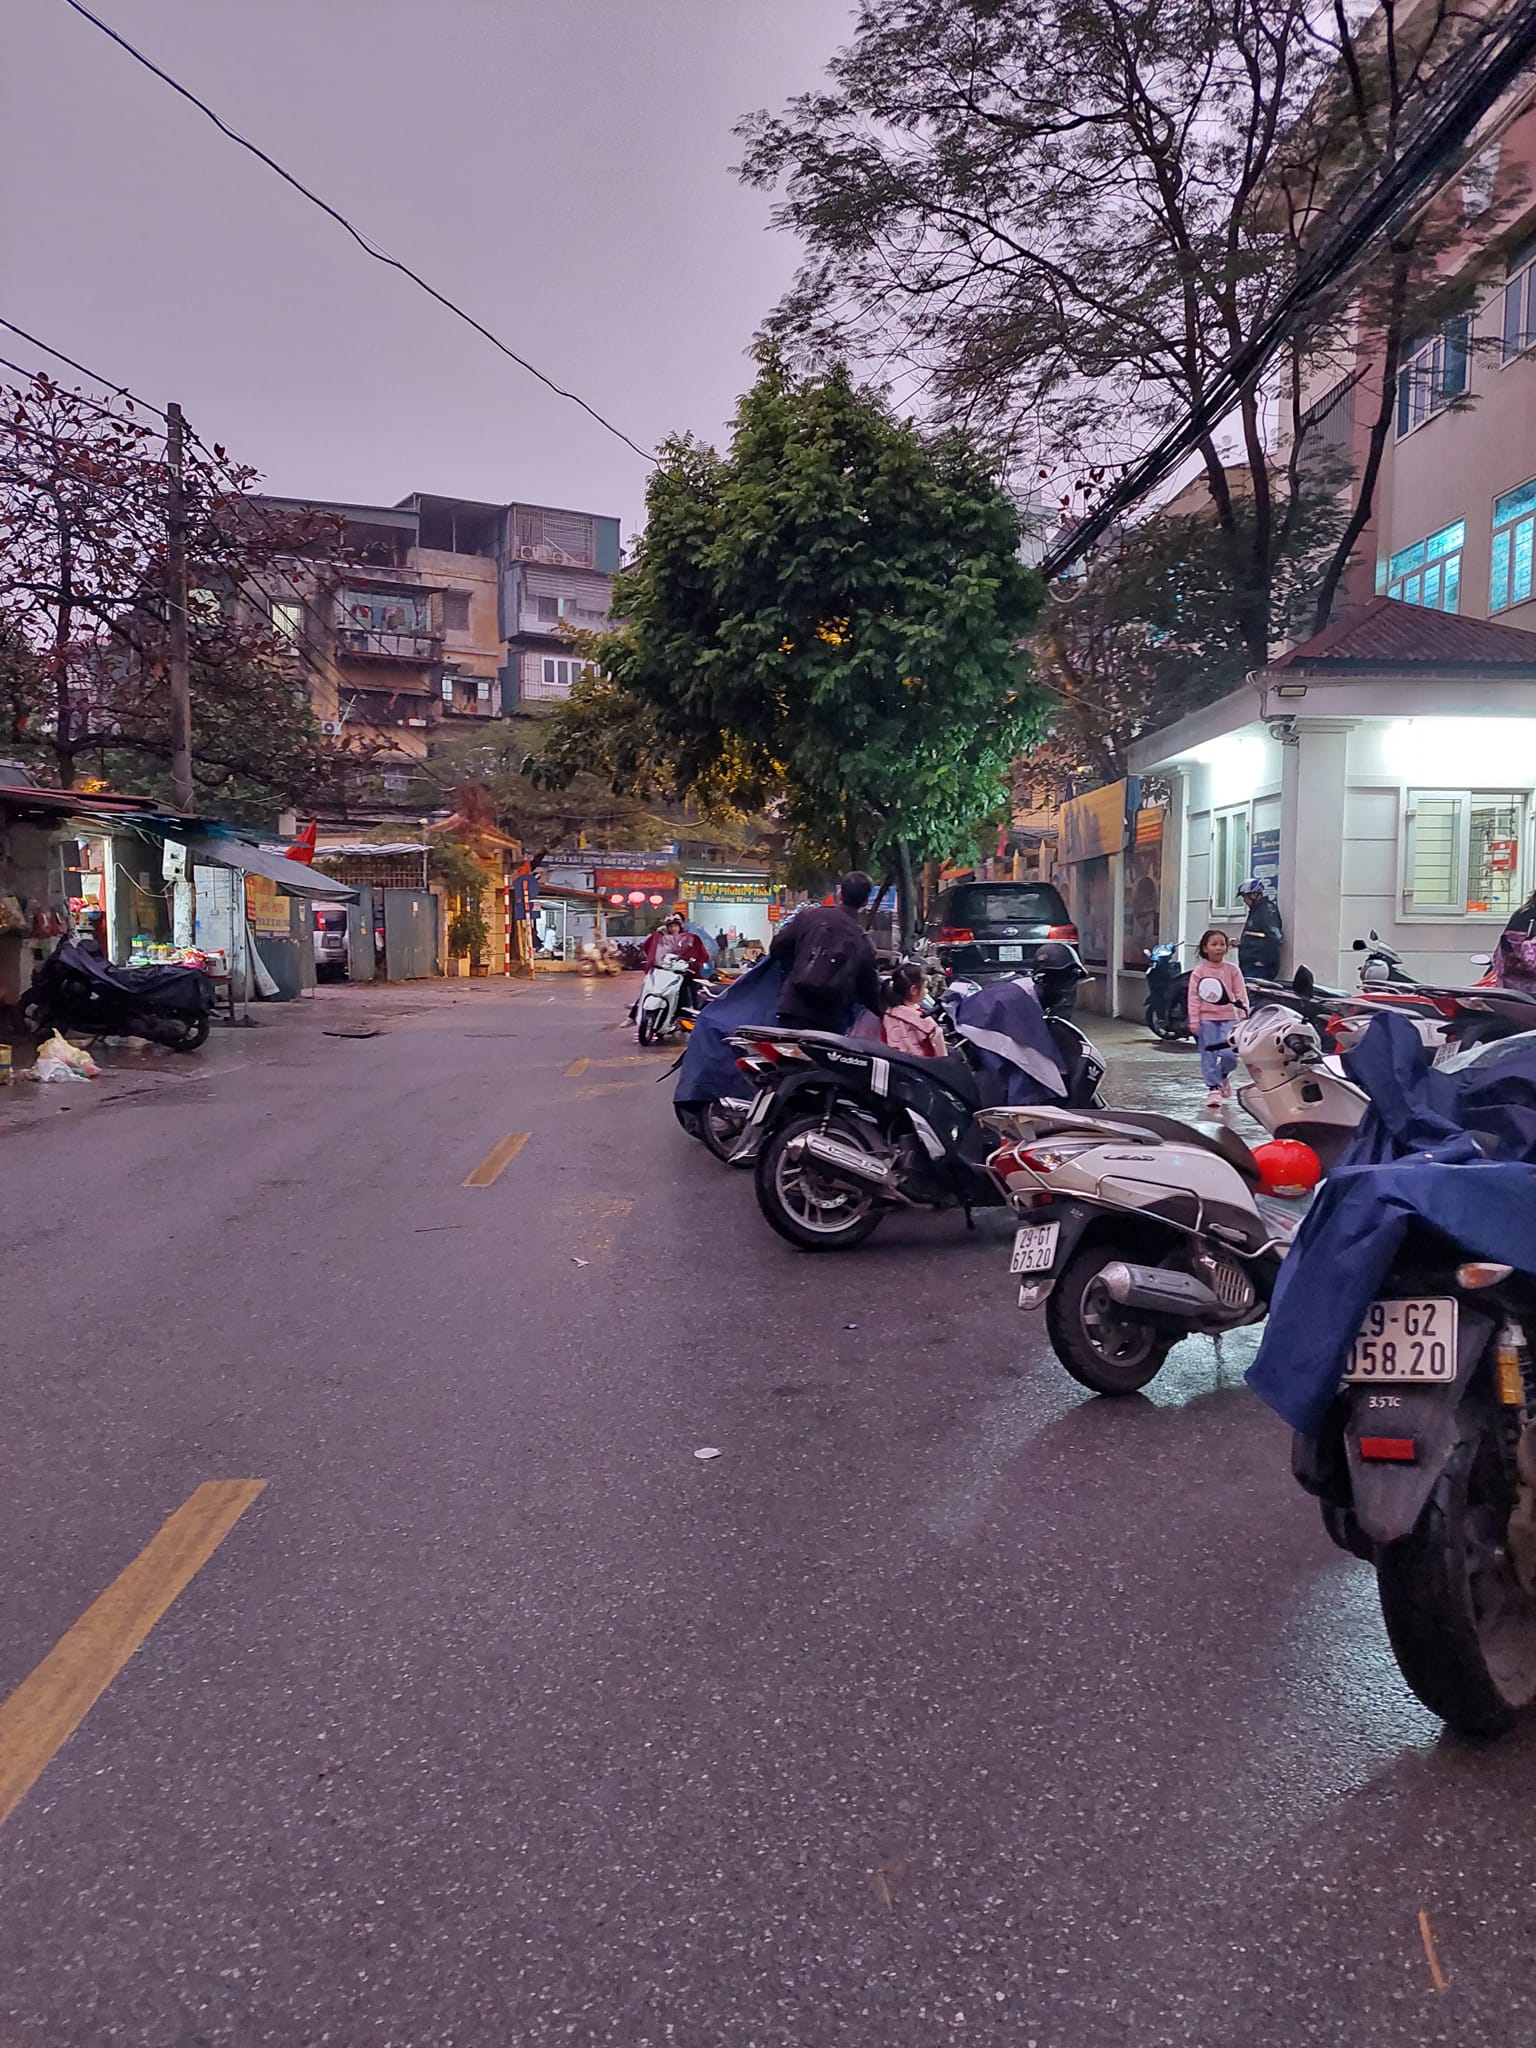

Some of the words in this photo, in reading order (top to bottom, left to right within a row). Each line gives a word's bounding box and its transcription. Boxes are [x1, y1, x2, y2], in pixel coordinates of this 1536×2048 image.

[840, 1057, 868, 1067] adidas
[1019, 1226, 1051, 1249] 29-G1
[1012, 1247, 1051, 1271] 675.20
[1359, 1303, 1437, 1337] 9-G2
